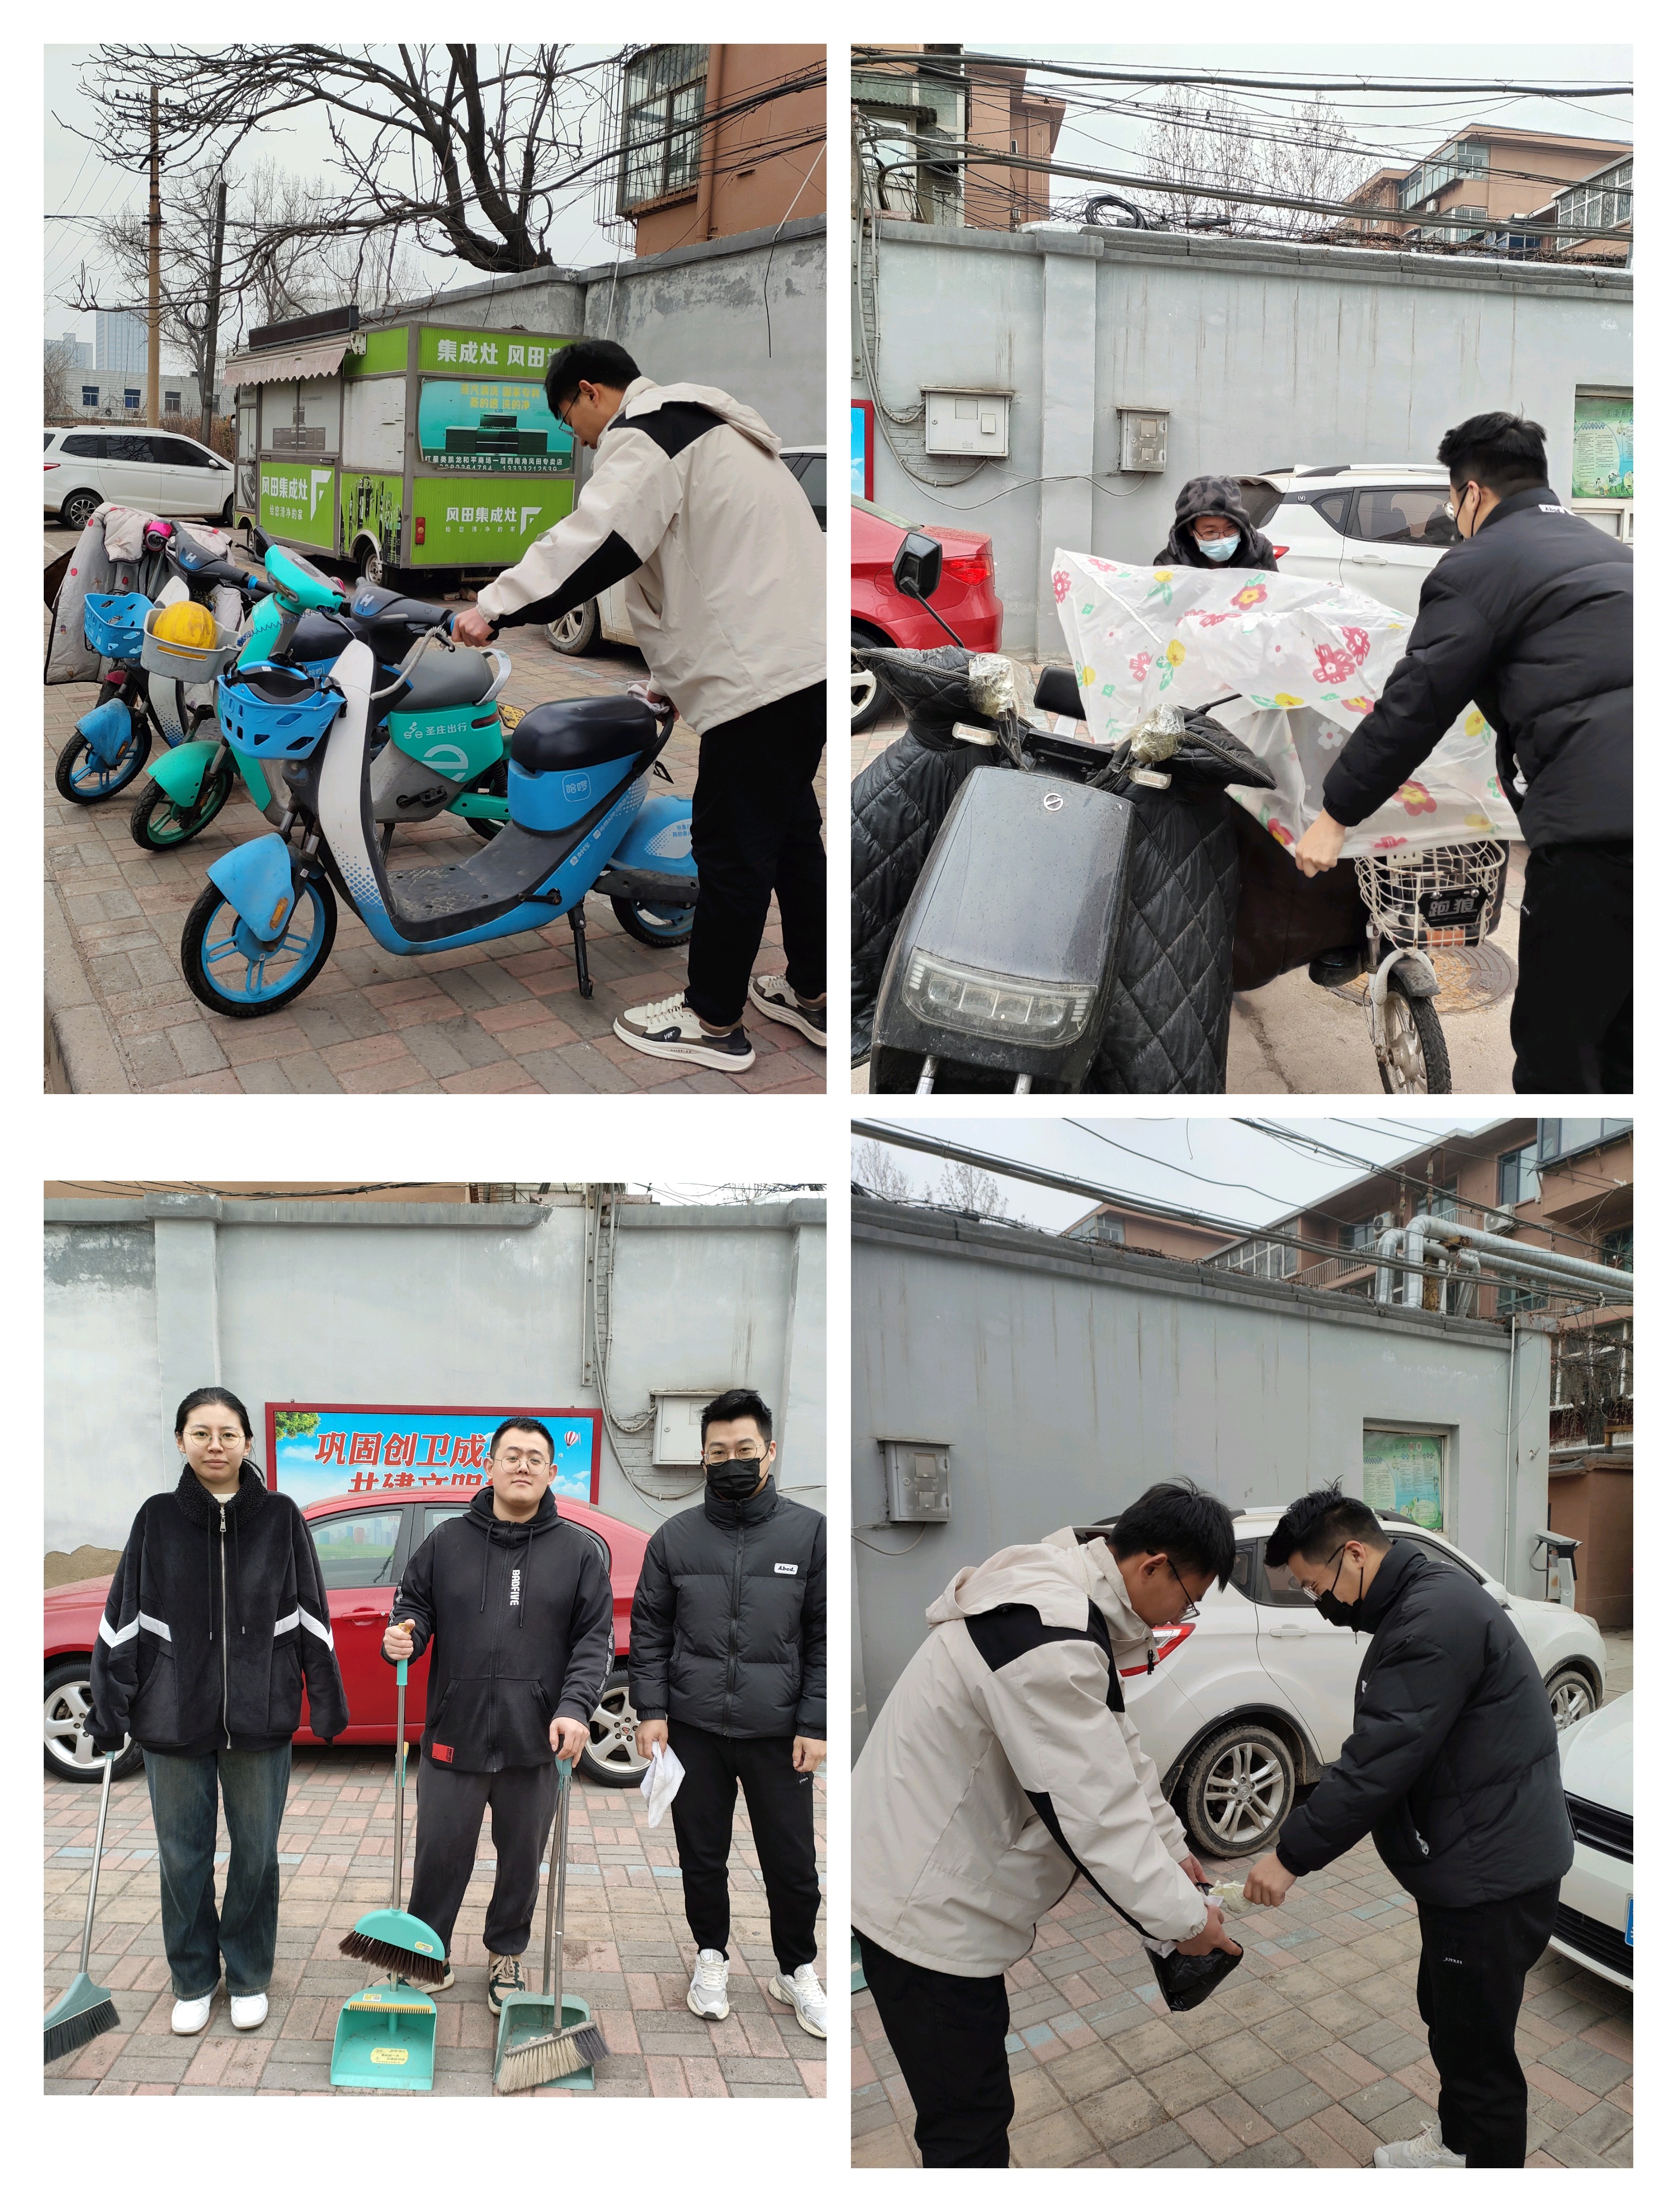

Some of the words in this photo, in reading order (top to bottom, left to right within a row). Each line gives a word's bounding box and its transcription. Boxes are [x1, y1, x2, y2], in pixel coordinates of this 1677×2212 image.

[438, 339, 498, 365] 集成灶
[461, 383, 498, 396] 蒸汽清洗
[503, 386, 540, 398] 国家专利
[502, 399, 530, 410] 洗的净
[424, 455, 563, 466] 红星美凯龙和平商场一层西南角风田专卖店
[261, 476, 308, 501] 风田集成灶
[269, 504, 303, 521] 给您清净的家
[445, 507, 517, 523] 风田集成灶
[425, 722, 467, 736] 圣庄出行
[566, 780, 587, 793] 哈啰
[1428, 898, 1478, 917] 跑狼
[314, 1431, 492, 1468] 巩固创卫成
[510, 1569, 521, 1606] BADFIVE
